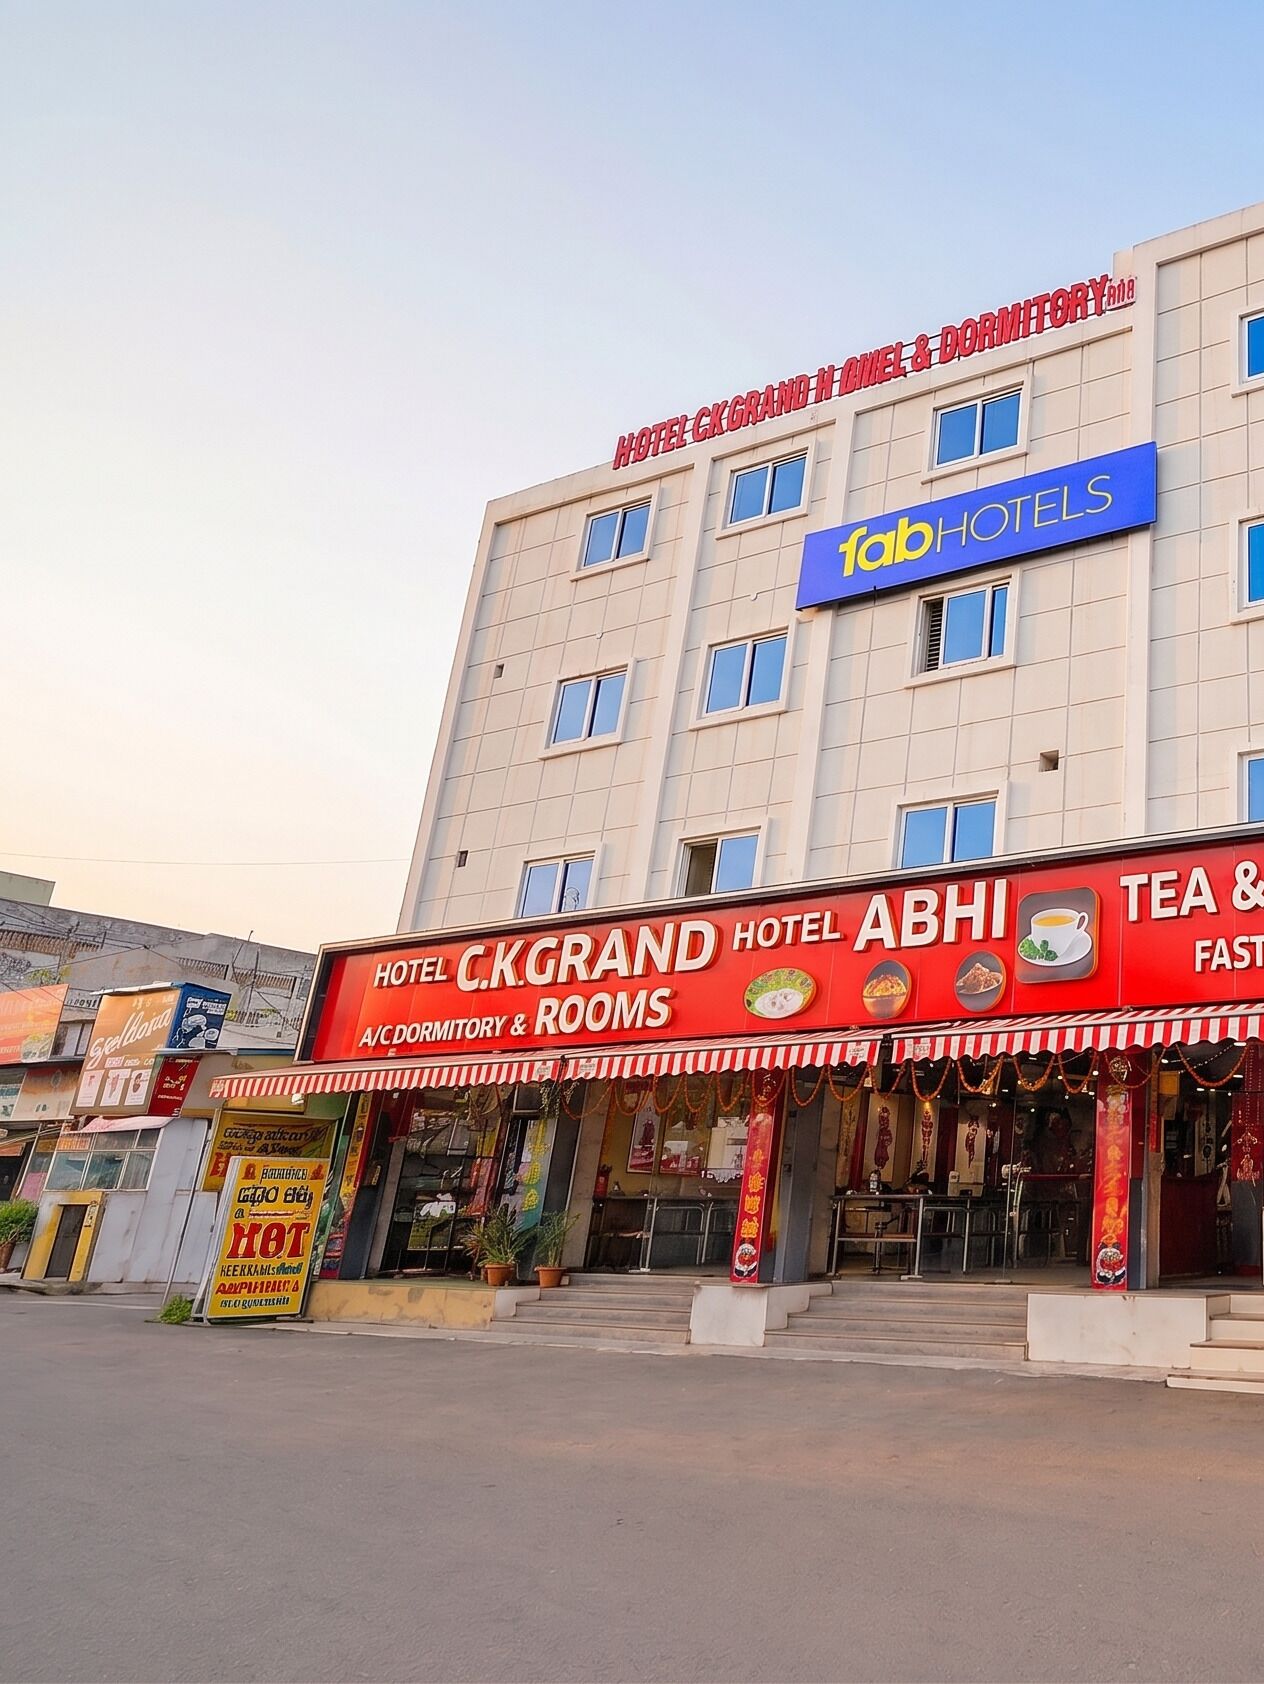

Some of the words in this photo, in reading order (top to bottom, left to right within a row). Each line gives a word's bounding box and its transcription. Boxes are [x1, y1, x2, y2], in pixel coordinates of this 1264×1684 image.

[612, 414, 688, 470] HOTEL
[910, 333, 931, 373] &
[938, 274, 1109, 364] DORMITORY
[732, 910, 842, 951] HOTEL
[853, 878, 1007, 952] ABHI
[1119, 866, 1219, 922] TEA
[372, 956, 449, 988] HOTEL
[392, 1015, 508, 1046] DORMITORY
[510, 1013, 528, 1036] &
[534, 987, 673, 1036] ROOMS
